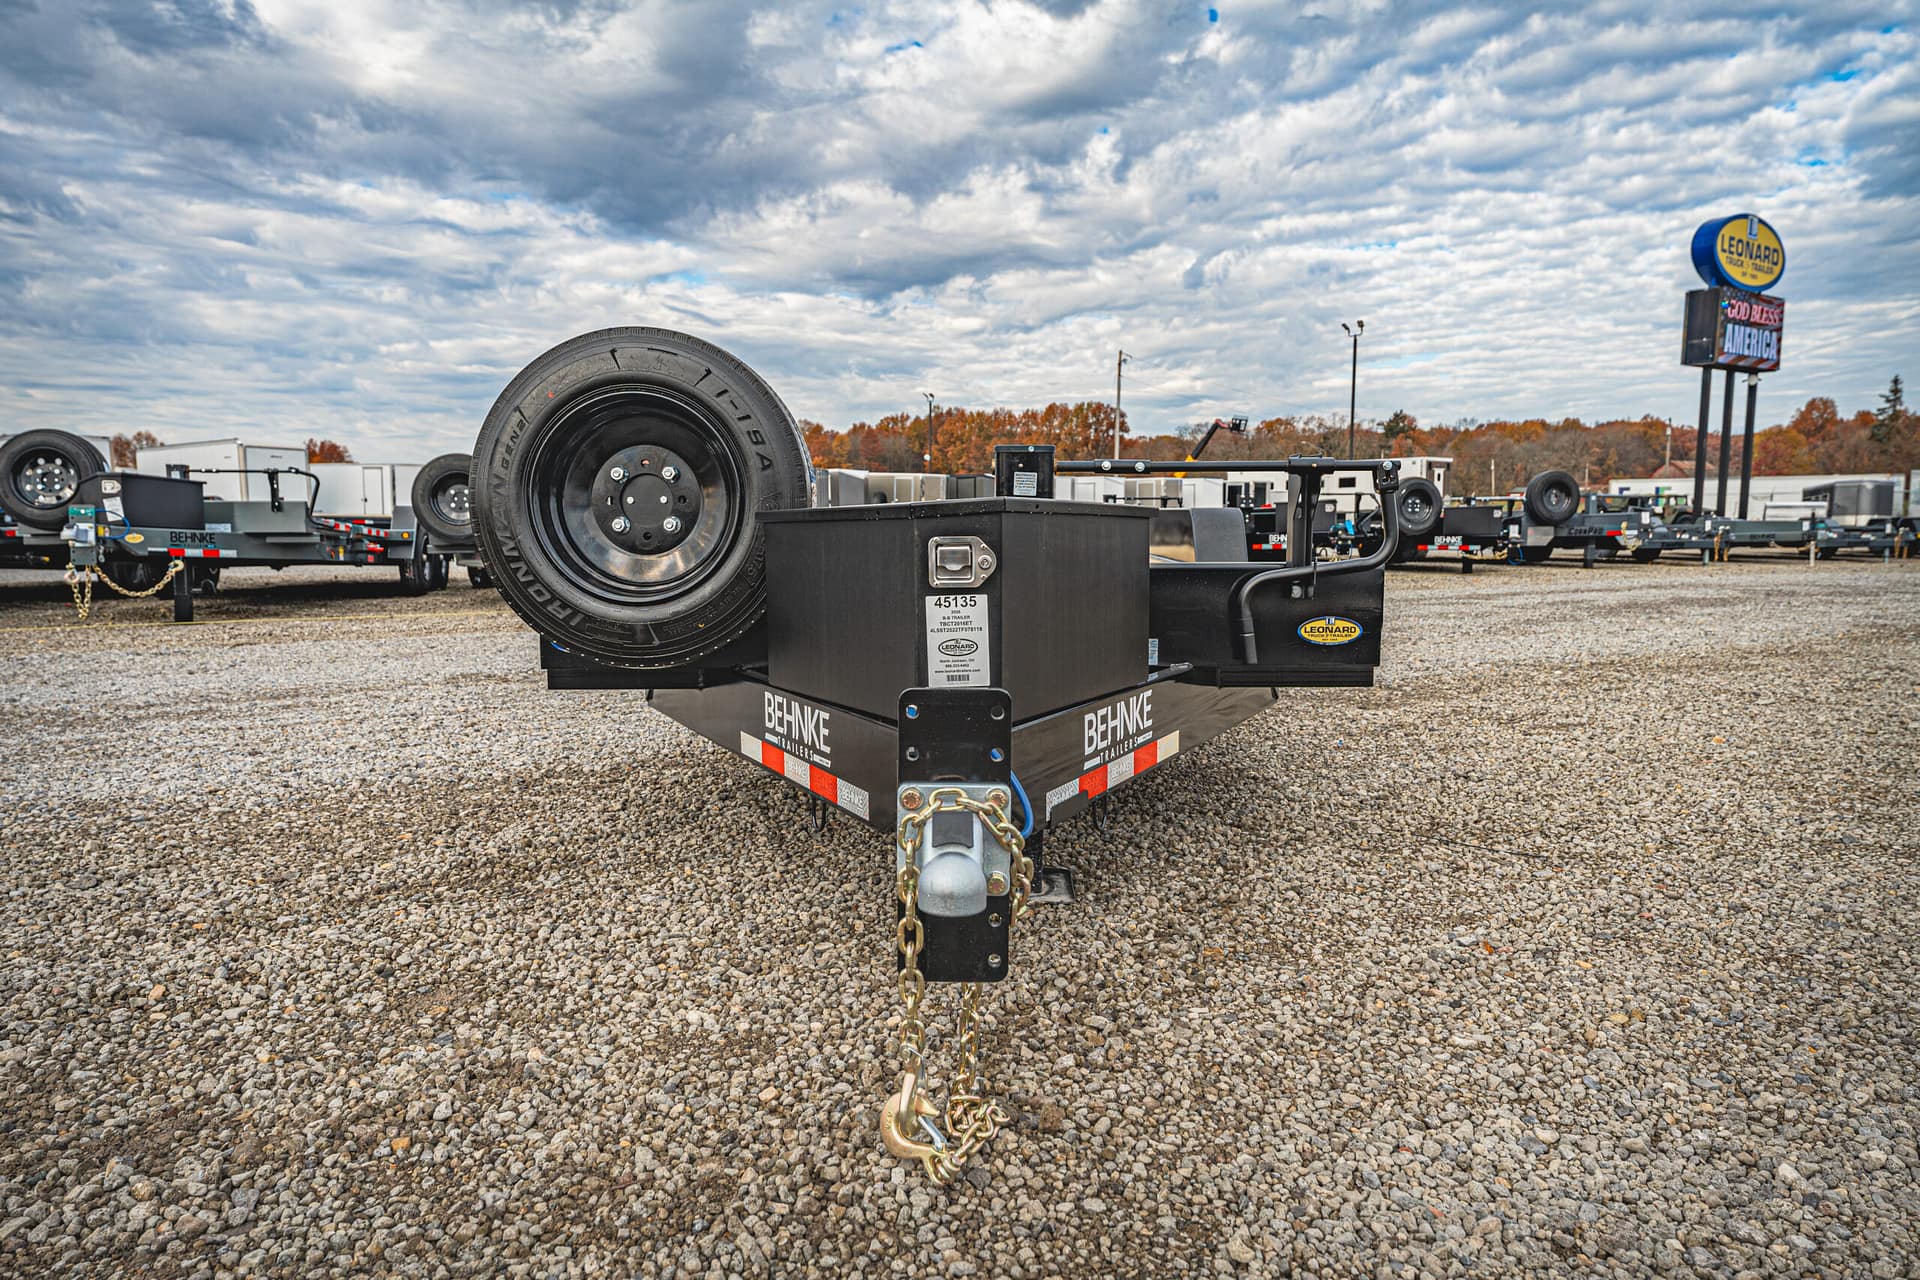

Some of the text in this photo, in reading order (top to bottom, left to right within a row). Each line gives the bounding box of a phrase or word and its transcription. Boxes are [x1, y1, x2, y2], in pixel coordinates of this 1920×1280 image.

[1721, 233, 1780, 267] LEONARD
[1726, 255, 1744, 268] TRUCK
[1727, 299, 1780, 326] GOD BLESS
[1723, 323, 1777, 361] AMERICA
[169, 530, 217, 544] BEHNKE
[490, 474, 586, 627] IRONMAN
[1434, 535, 1463, 546] BEHNKE
[934, 595, 977, 608] 45135
[1304, 626, 1357, 634] LEONARD
[764, 691, 831, 754] BEHNKE
[1084, 689, 1153, 756] BEHNKE
[777, 735, 815, 762] TRAILERS
[1099, 736, 1139, 764] TRAILERS
